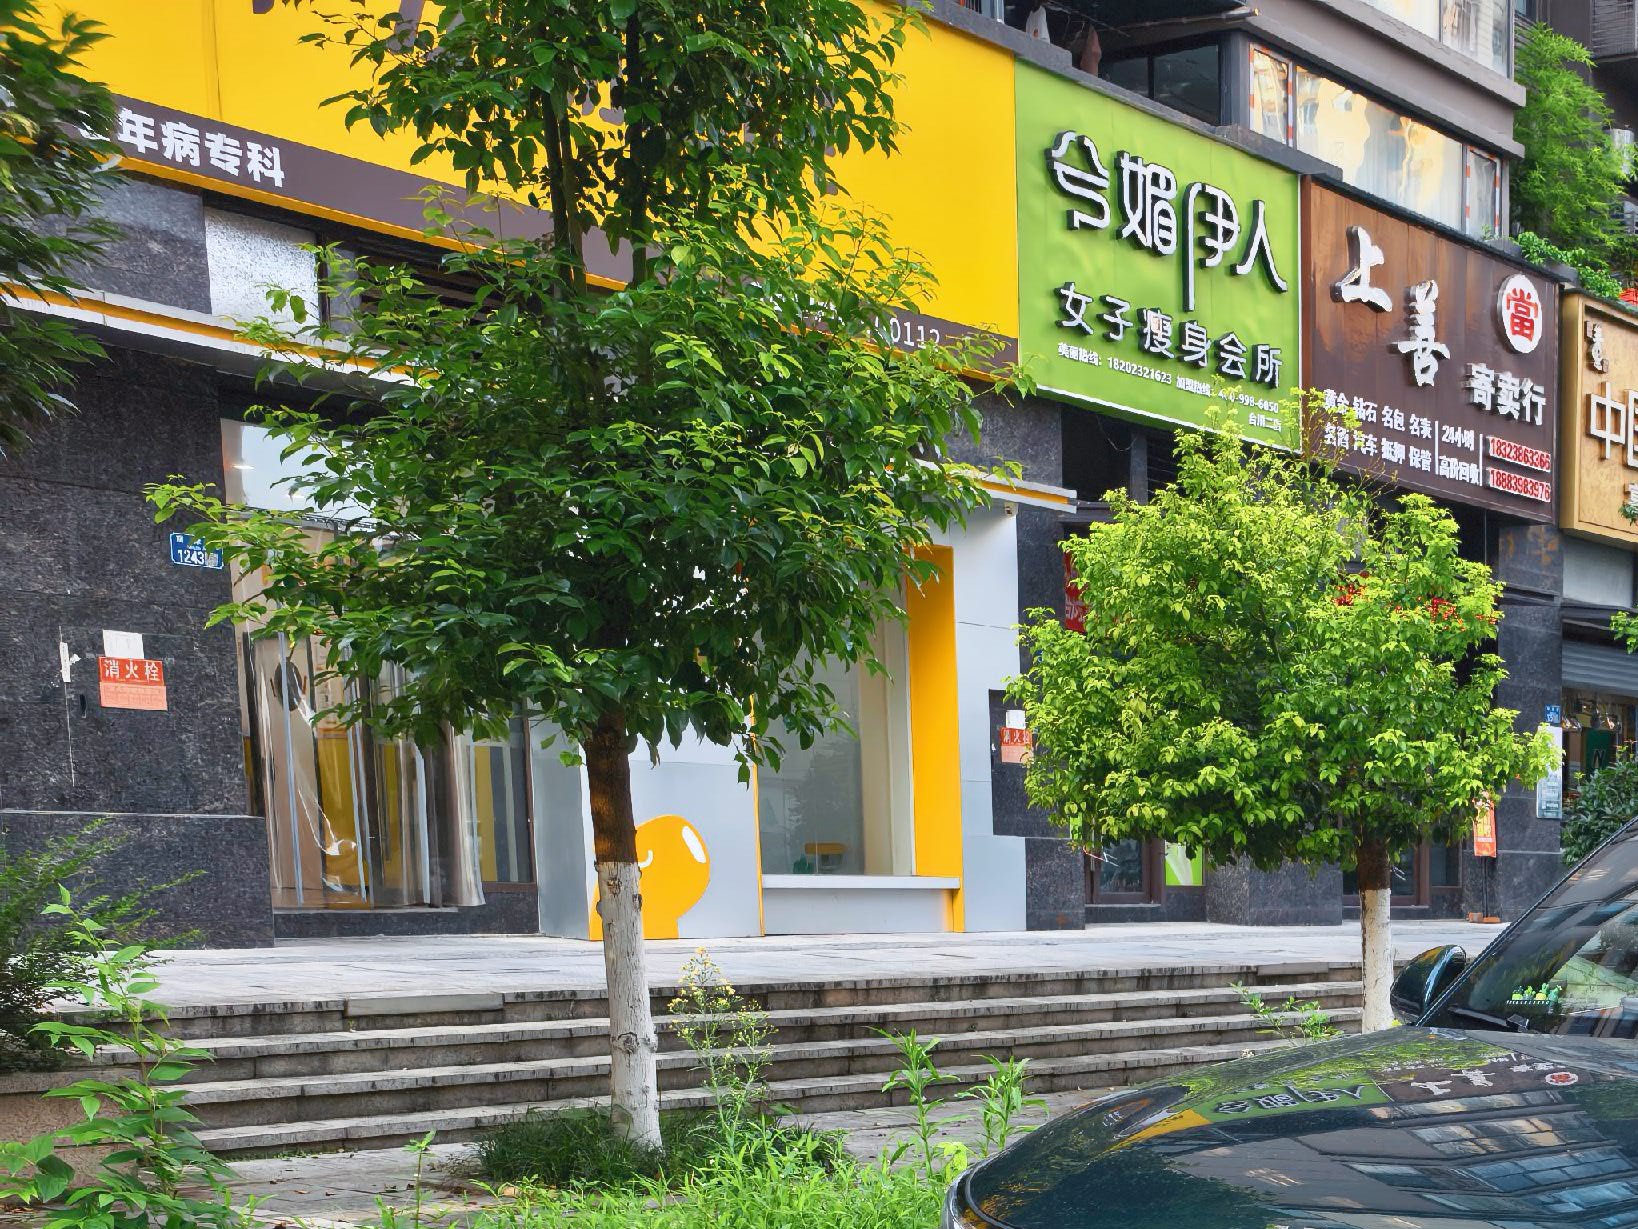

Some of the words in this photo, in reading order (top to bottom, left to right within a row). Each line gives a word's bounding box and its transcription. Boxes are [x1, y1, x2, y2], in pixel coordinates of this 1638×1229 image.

[1057, 281, 1283, 390] 女子瘦身会所
[1333, 225, 1450, 387] 上善
[1505, 286, 1540, 341] 當
[1467, 362, 1547, 426] 寄卖行
[1441, 424, 1475, 451] 24小时
[103, 659, 160, 682] 消火栓
